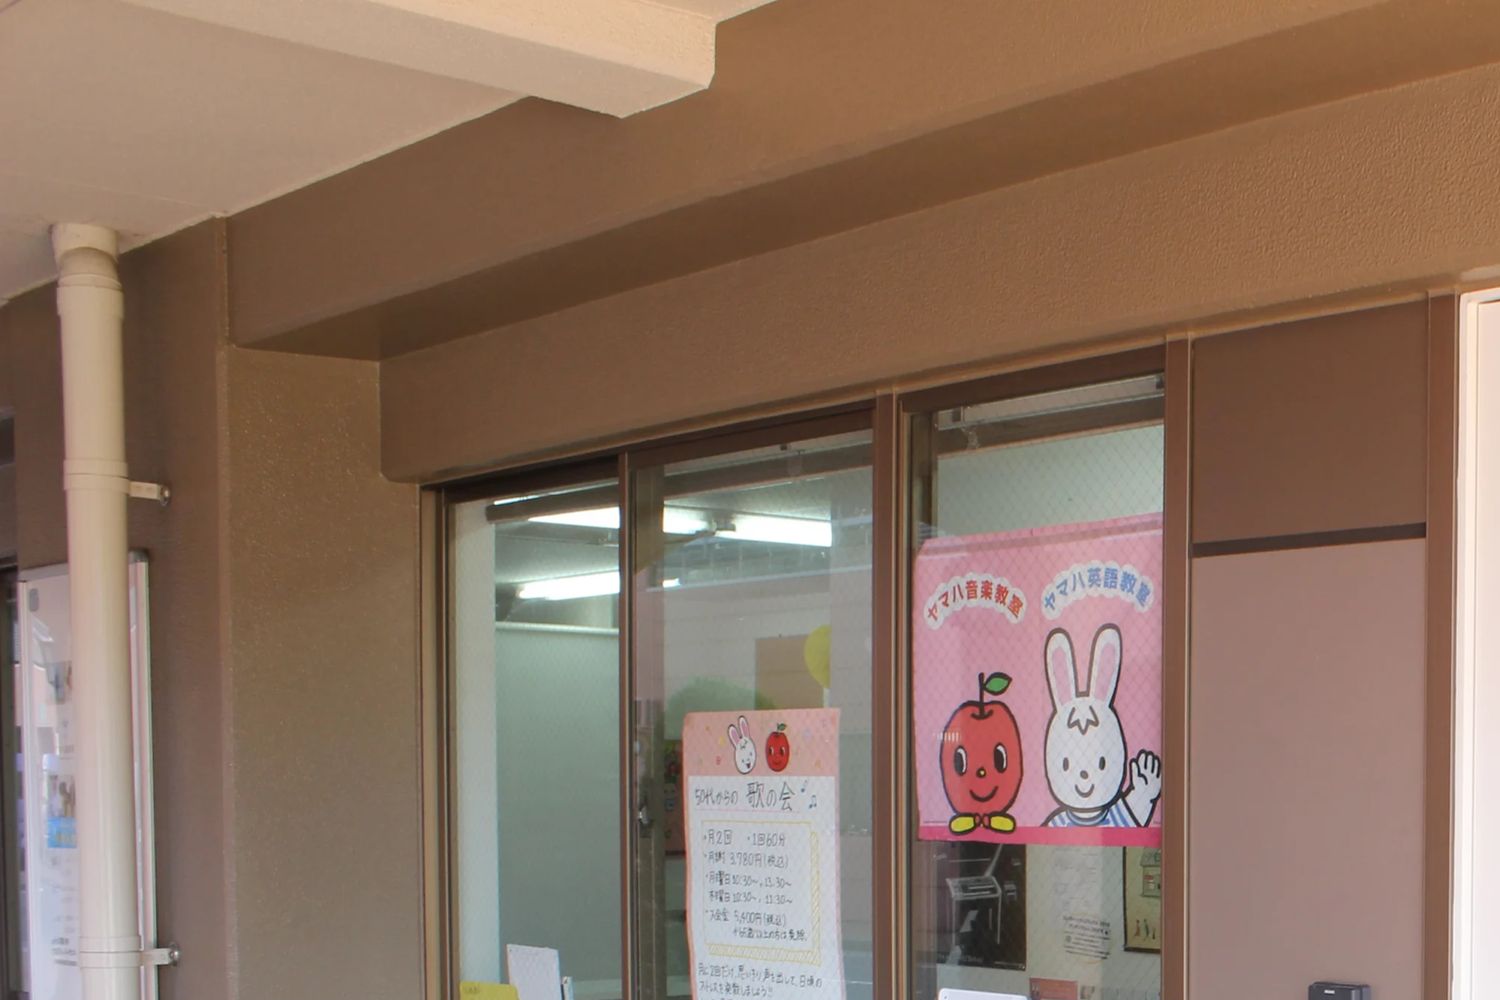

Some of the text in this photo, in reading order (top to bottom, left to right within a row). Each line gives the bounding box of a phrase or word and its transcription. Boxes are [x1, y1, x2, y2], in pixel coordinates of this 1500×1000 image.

[927, 580, 1025, 621] ヤマハ音楽教室
[1044, 567, 1152, 611] ヤマハ英語教室
